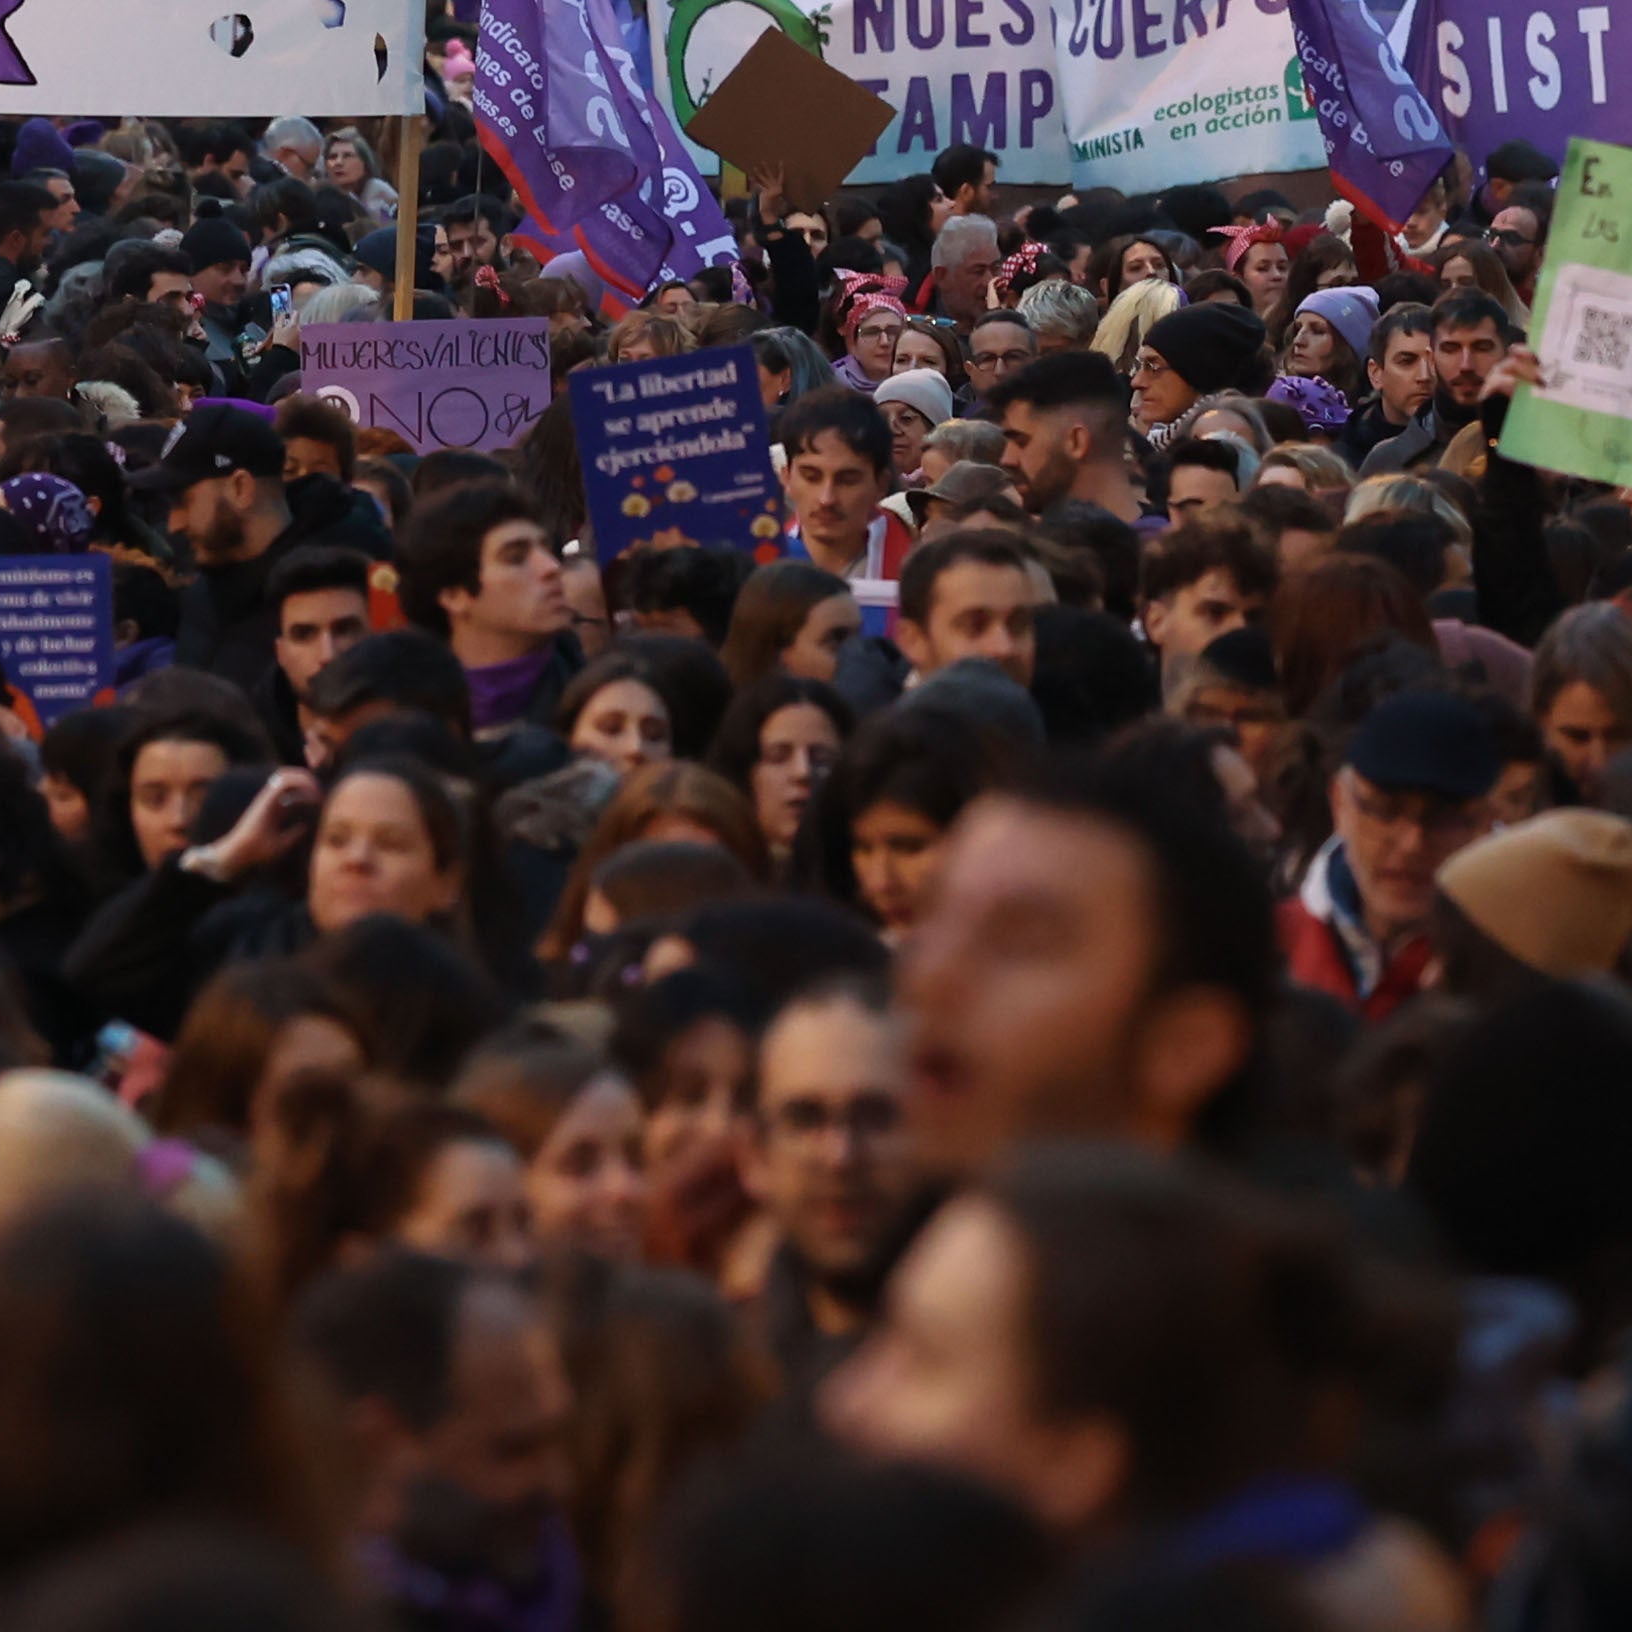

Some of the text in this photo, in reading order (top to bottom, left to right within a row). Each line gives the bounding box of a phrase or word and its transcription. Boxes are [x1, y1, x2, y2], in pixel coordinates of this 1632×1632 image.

[511, 87, 534, 121] de
[1154, 83, 1279, 122] ecologistas
[1171, 122, 1196, 140] en
[1204, 105, 1281, 136] acción
[638, 360, 738, 399] libertad
[604, 396, 738, 437] se aprende
[29, 591, 51, 608] de
